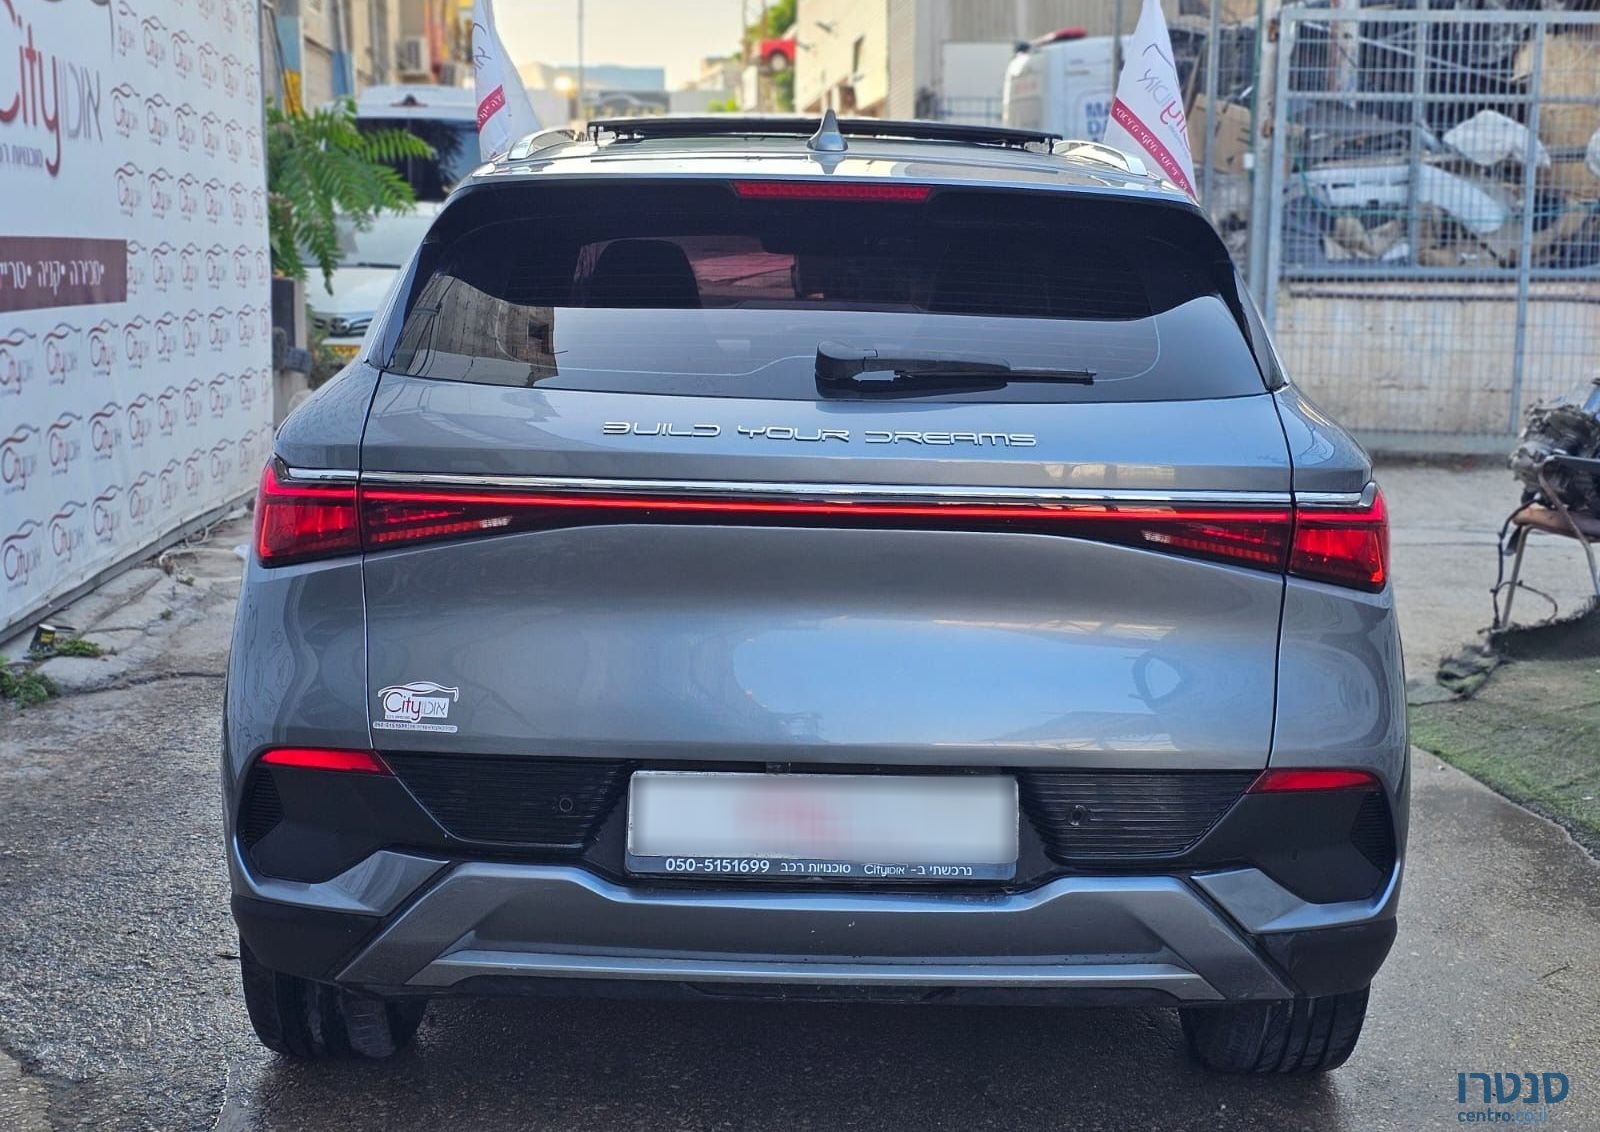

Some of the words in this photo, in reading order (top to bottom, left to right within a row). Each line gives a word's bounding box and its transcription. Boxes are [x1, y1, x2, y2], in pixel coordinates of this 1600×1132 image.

[603, 421, 721, 437] BUILD
[737, 424, 850, 443] YOUR
[864, 430, 1037, 448] DREAMS
[665, 858, 770, 873] 050-5151699
[780, 861, 804, 872] רכב
[807, 862, 851, 873] סוכנויות
[929, 865, 972, 875] נרכשתי
